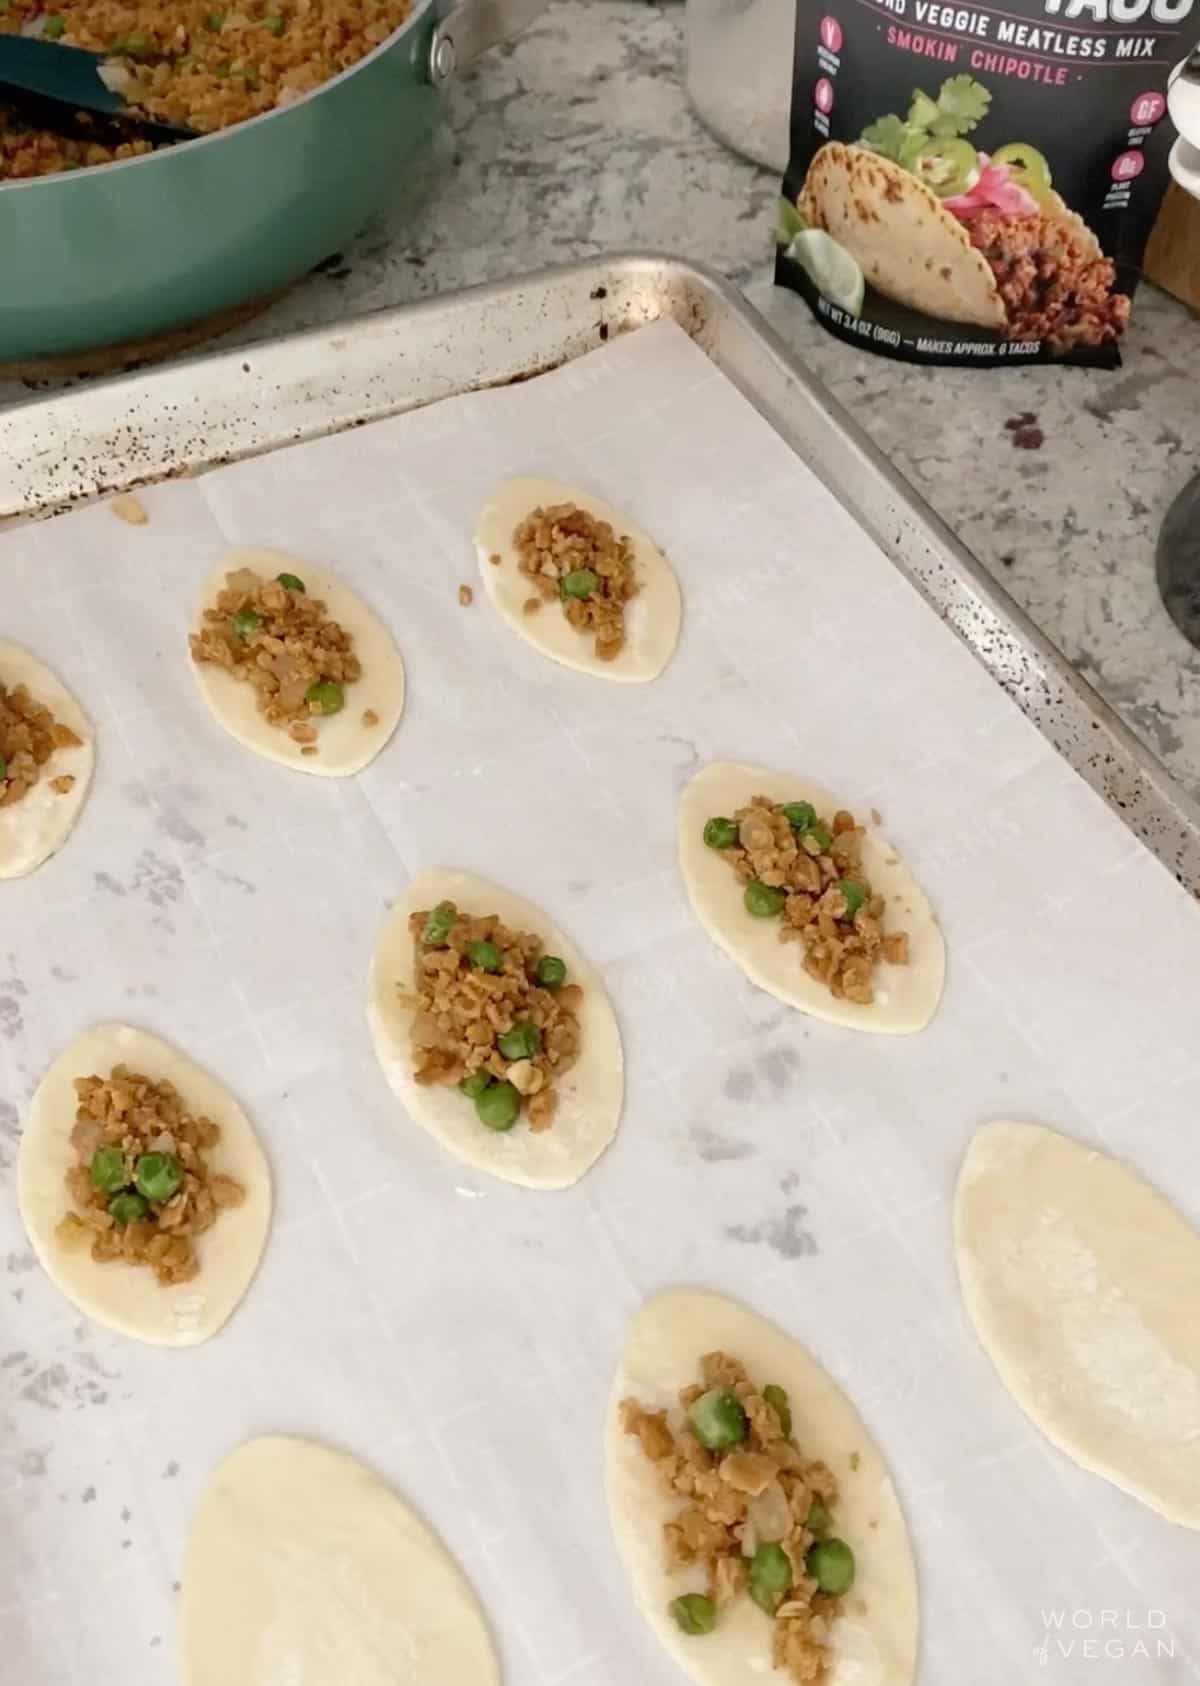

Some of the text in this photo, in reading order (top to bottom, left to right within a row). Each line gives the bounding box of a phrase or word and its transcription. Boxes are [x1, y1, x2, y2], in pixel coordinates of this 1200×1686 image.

[915, 1, 991, 36] VEGGIE
[997, 22, 1107, 58] MEATLESS
[1115, 37, 1156, 58] MIX
[970, 50, 1069, 85] CHIPOTLE
[859, 320, 873, 337] OZ
[916, 338, 953, 354] MAKES
[1008, 340, 1041, 355] TACOS
